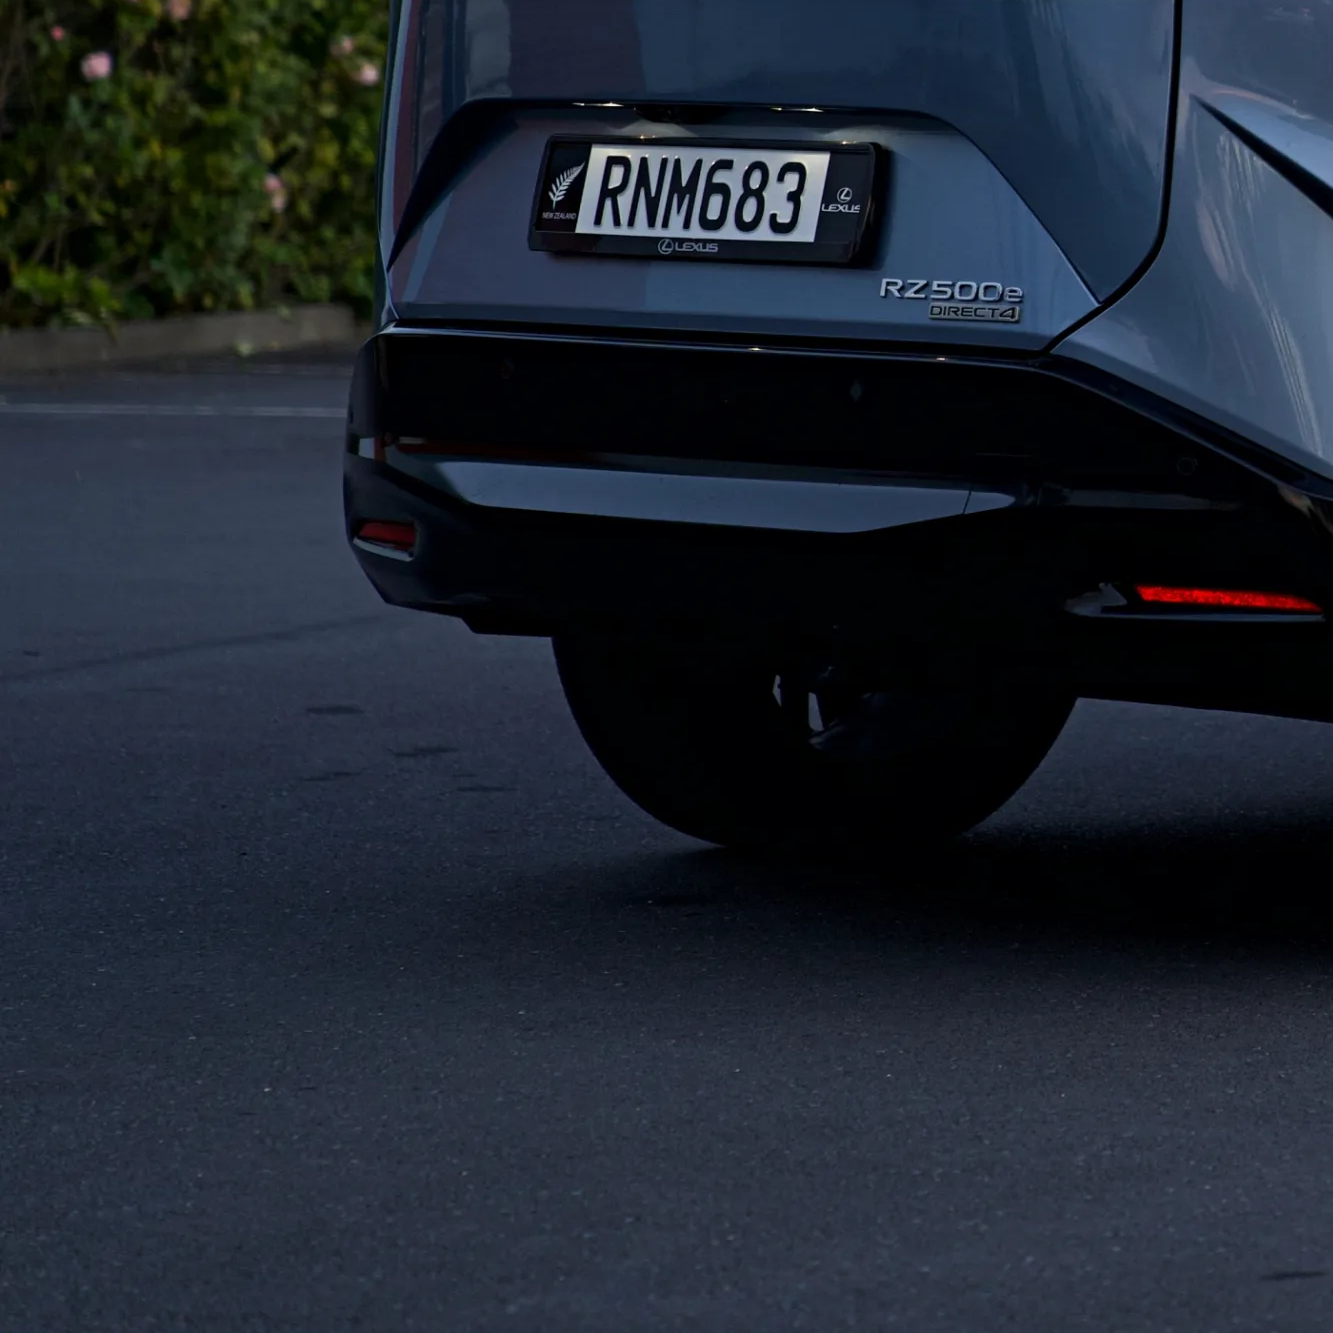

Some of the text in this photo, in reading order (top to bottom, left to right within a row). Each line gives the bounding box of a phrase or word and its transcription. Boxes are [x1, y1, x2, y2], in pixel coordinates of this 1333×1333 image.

[593, 155, 807, 234] RNM683
[542, 211, 577, 220] NEW ZEALAND
[675, 241, 719, 252] LEXUS
[930, 305, 1017, 320] DIRECT4
